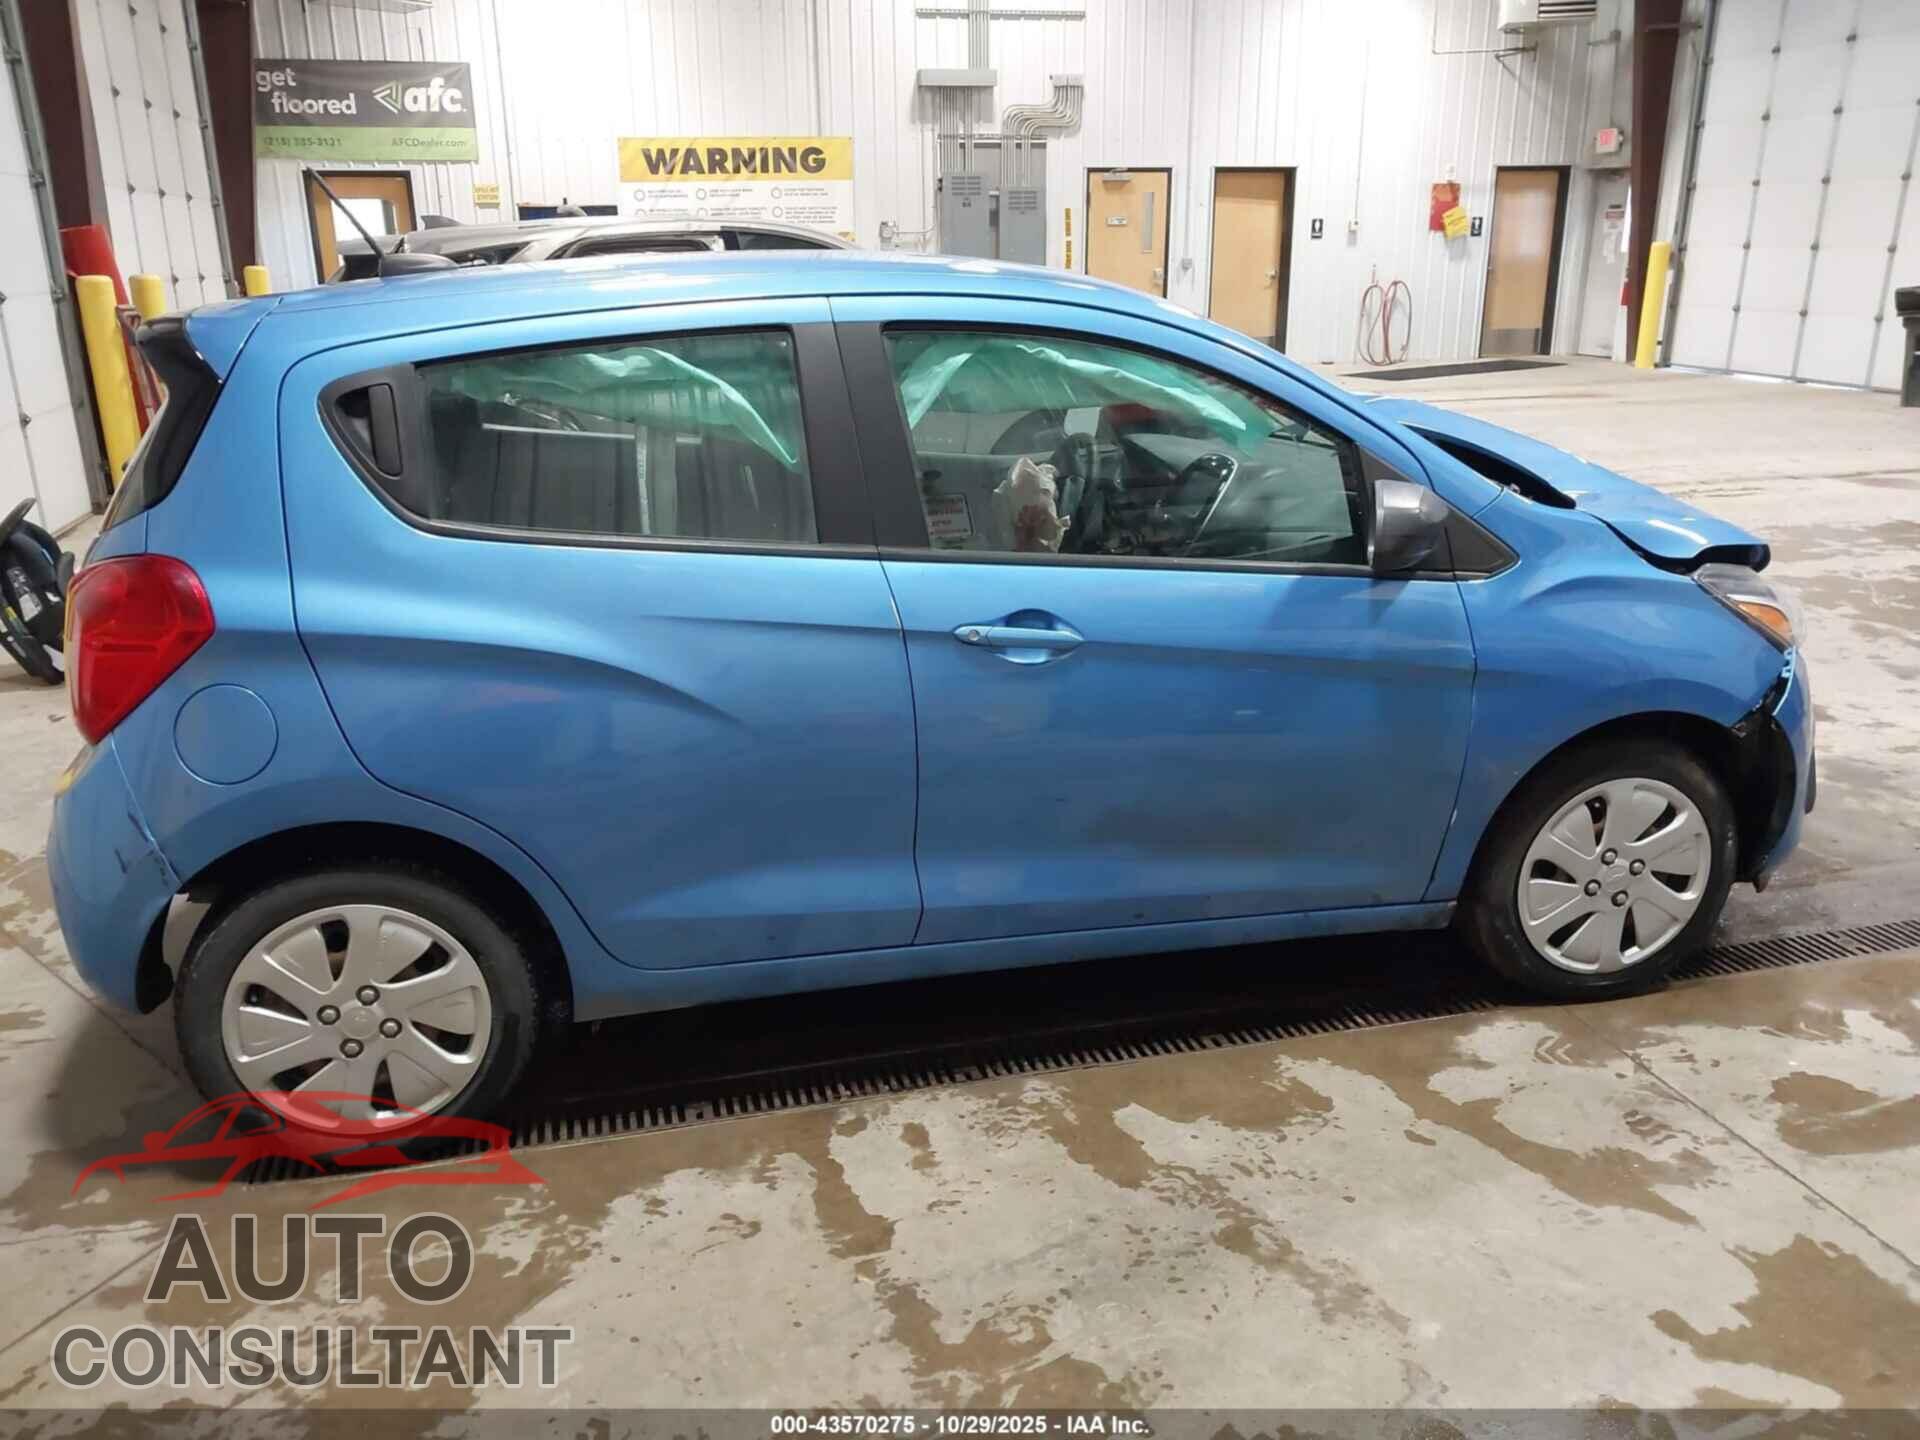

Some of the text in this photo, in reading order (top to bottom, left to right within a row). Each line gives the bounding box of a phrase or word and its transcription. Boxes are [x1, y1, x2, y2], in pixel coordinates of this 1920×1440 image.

[255, 67, 297, 92] get
[271, 91, 358, 115] floored
[641, 146, 827, 175] WARNING
